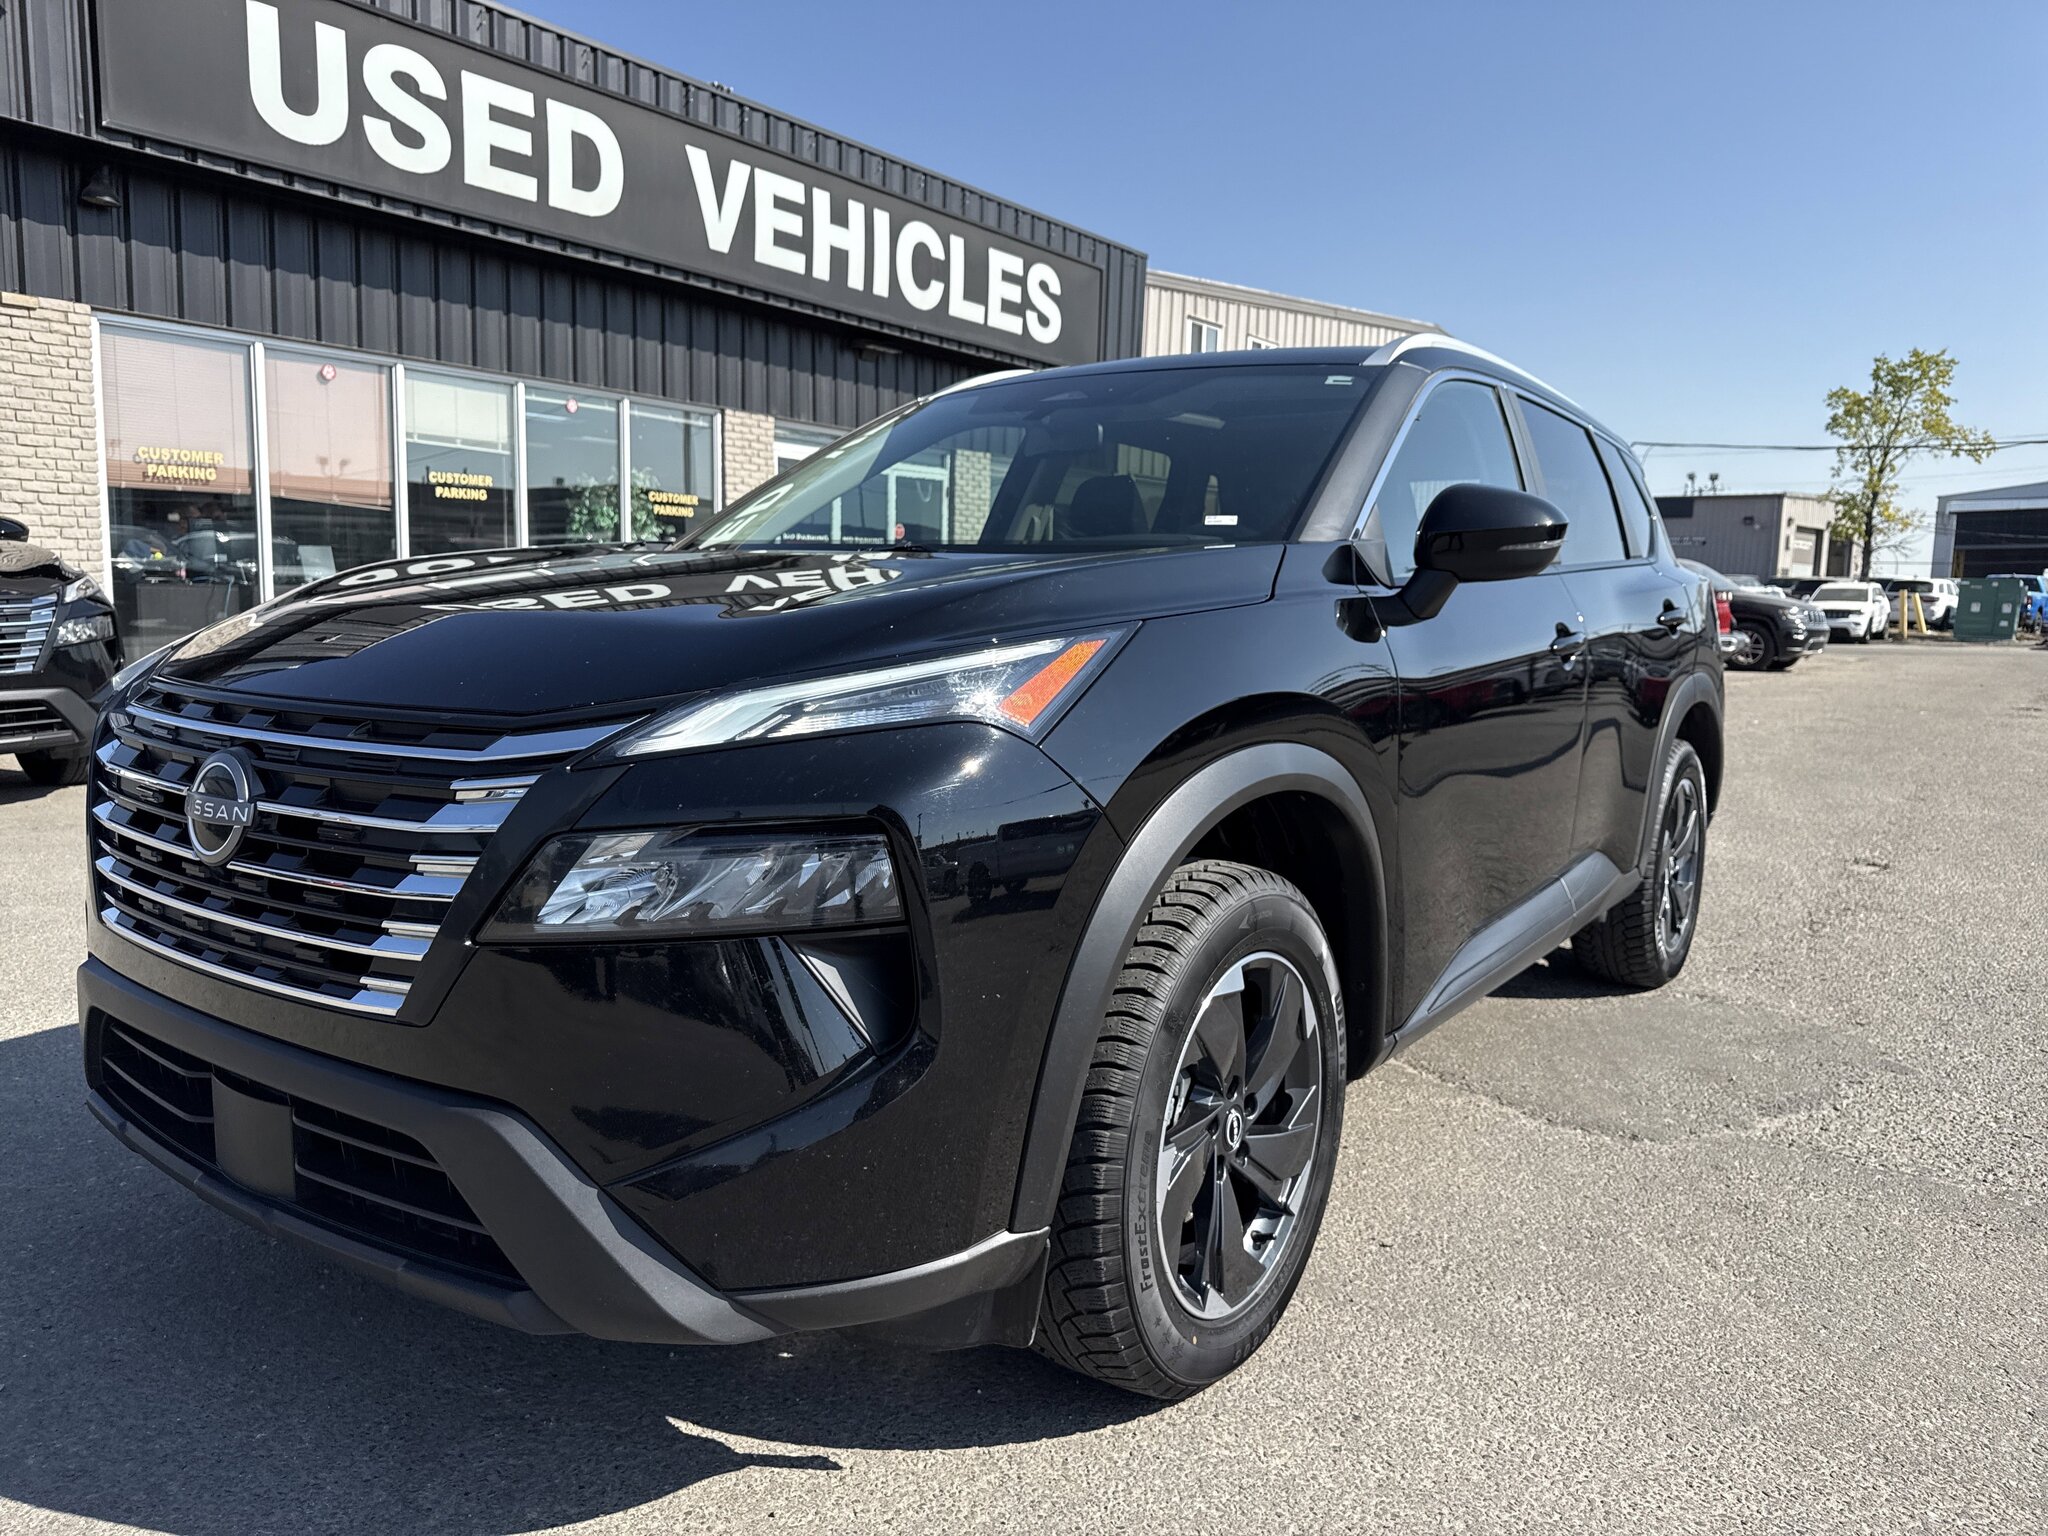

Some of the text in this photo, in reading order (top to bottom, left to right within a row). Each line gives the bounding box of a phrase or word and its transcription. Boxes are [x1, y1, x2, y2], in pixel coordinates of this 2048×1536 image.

[246, 0, 1062, 344] USED VEHICLES
[138, 447, 224, 464] CUSTOMER
[148, 464, 217, 480] PARKING
[428, 470, 493, 488] CUSTOMER
[434, 485, 488, 501] PARKING
[647, 490, 699, 506] CUSTOMER
[652, 503, 695, 518] PARKING
